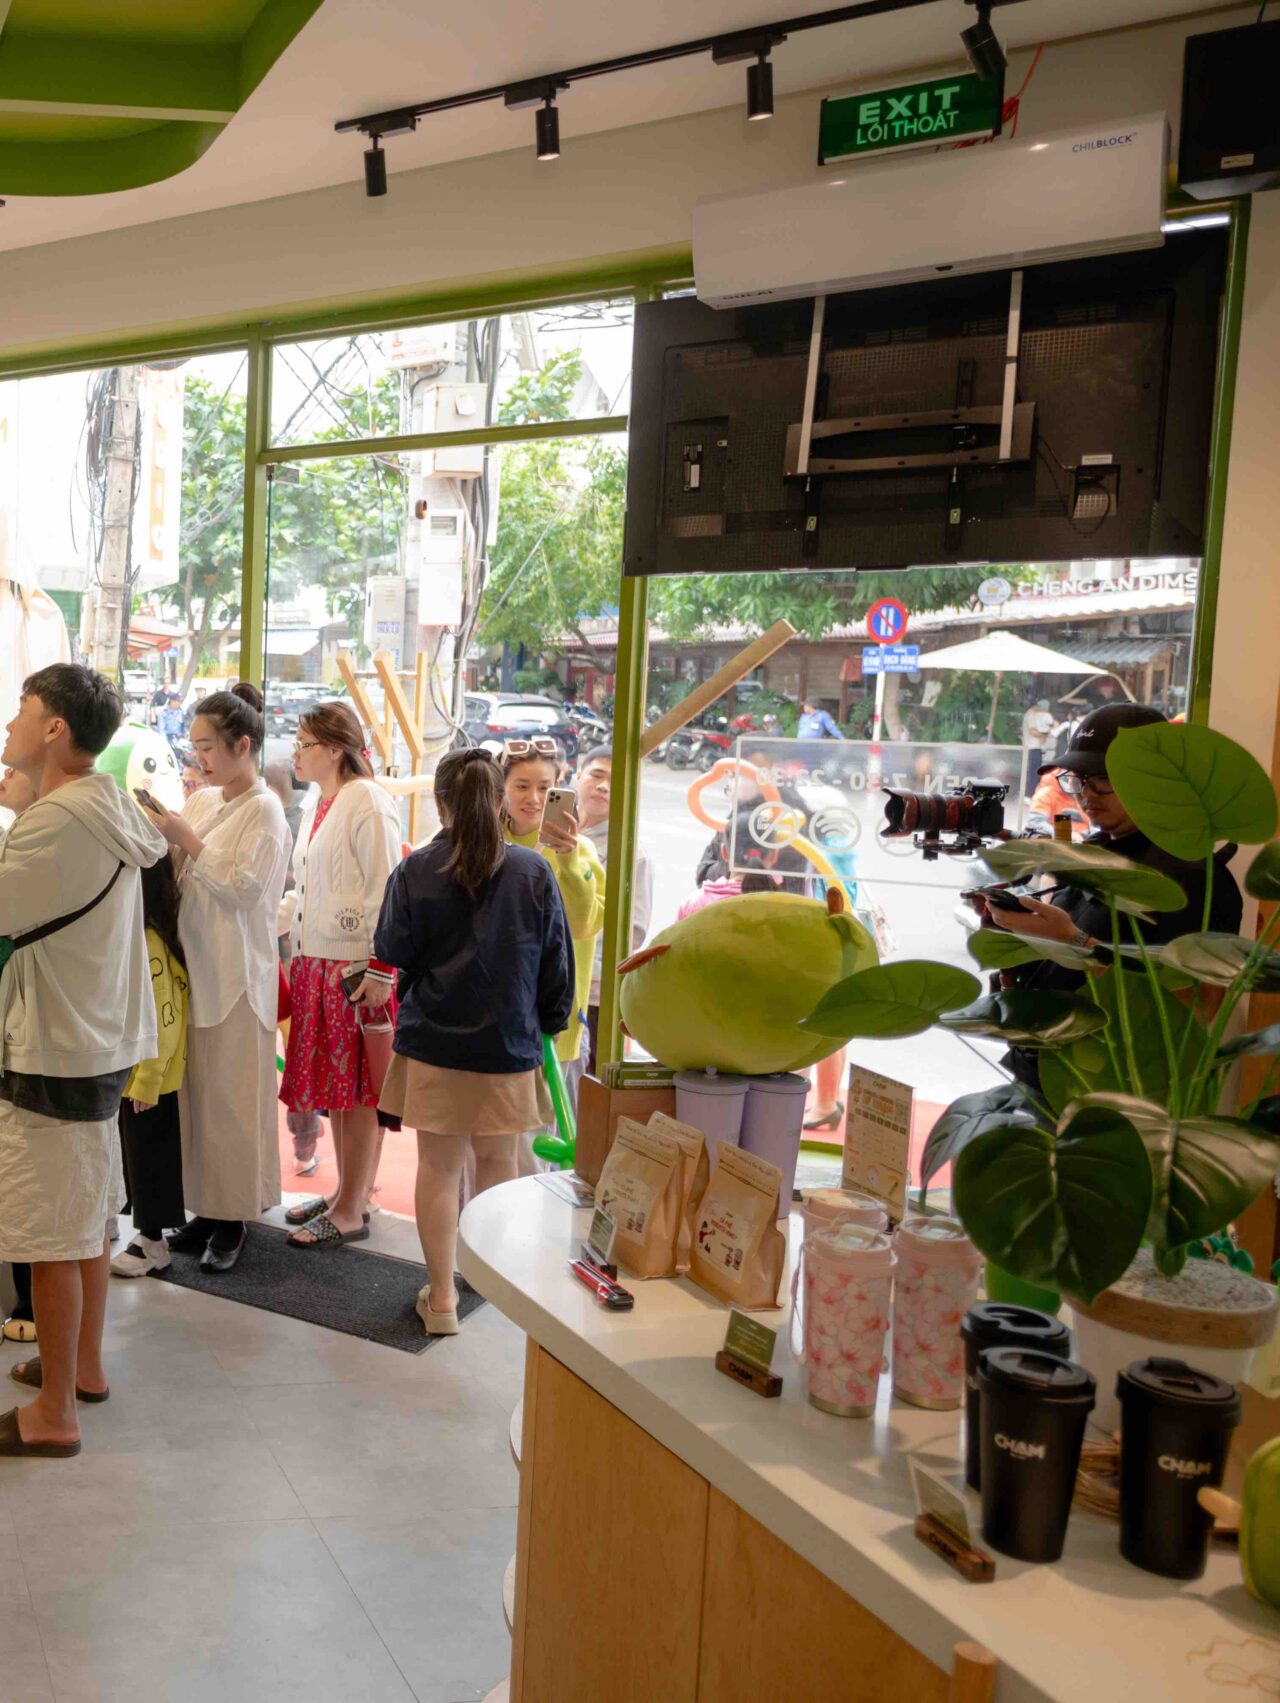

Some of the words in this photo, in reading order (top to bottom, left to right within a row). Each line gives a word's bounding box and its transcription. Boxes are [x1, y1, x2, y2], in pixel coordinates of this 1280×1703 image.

[858, 85, 961, 125] EXIT
[891, 109, 959, 138] THOÁT
[1018, 579, 1093, 597] CHENG
[1099, 577, 1134, 593] AN
[994, 1432, 1047, 1459] CHAM
[1157, 1454, 1212, 1475] CHAM
